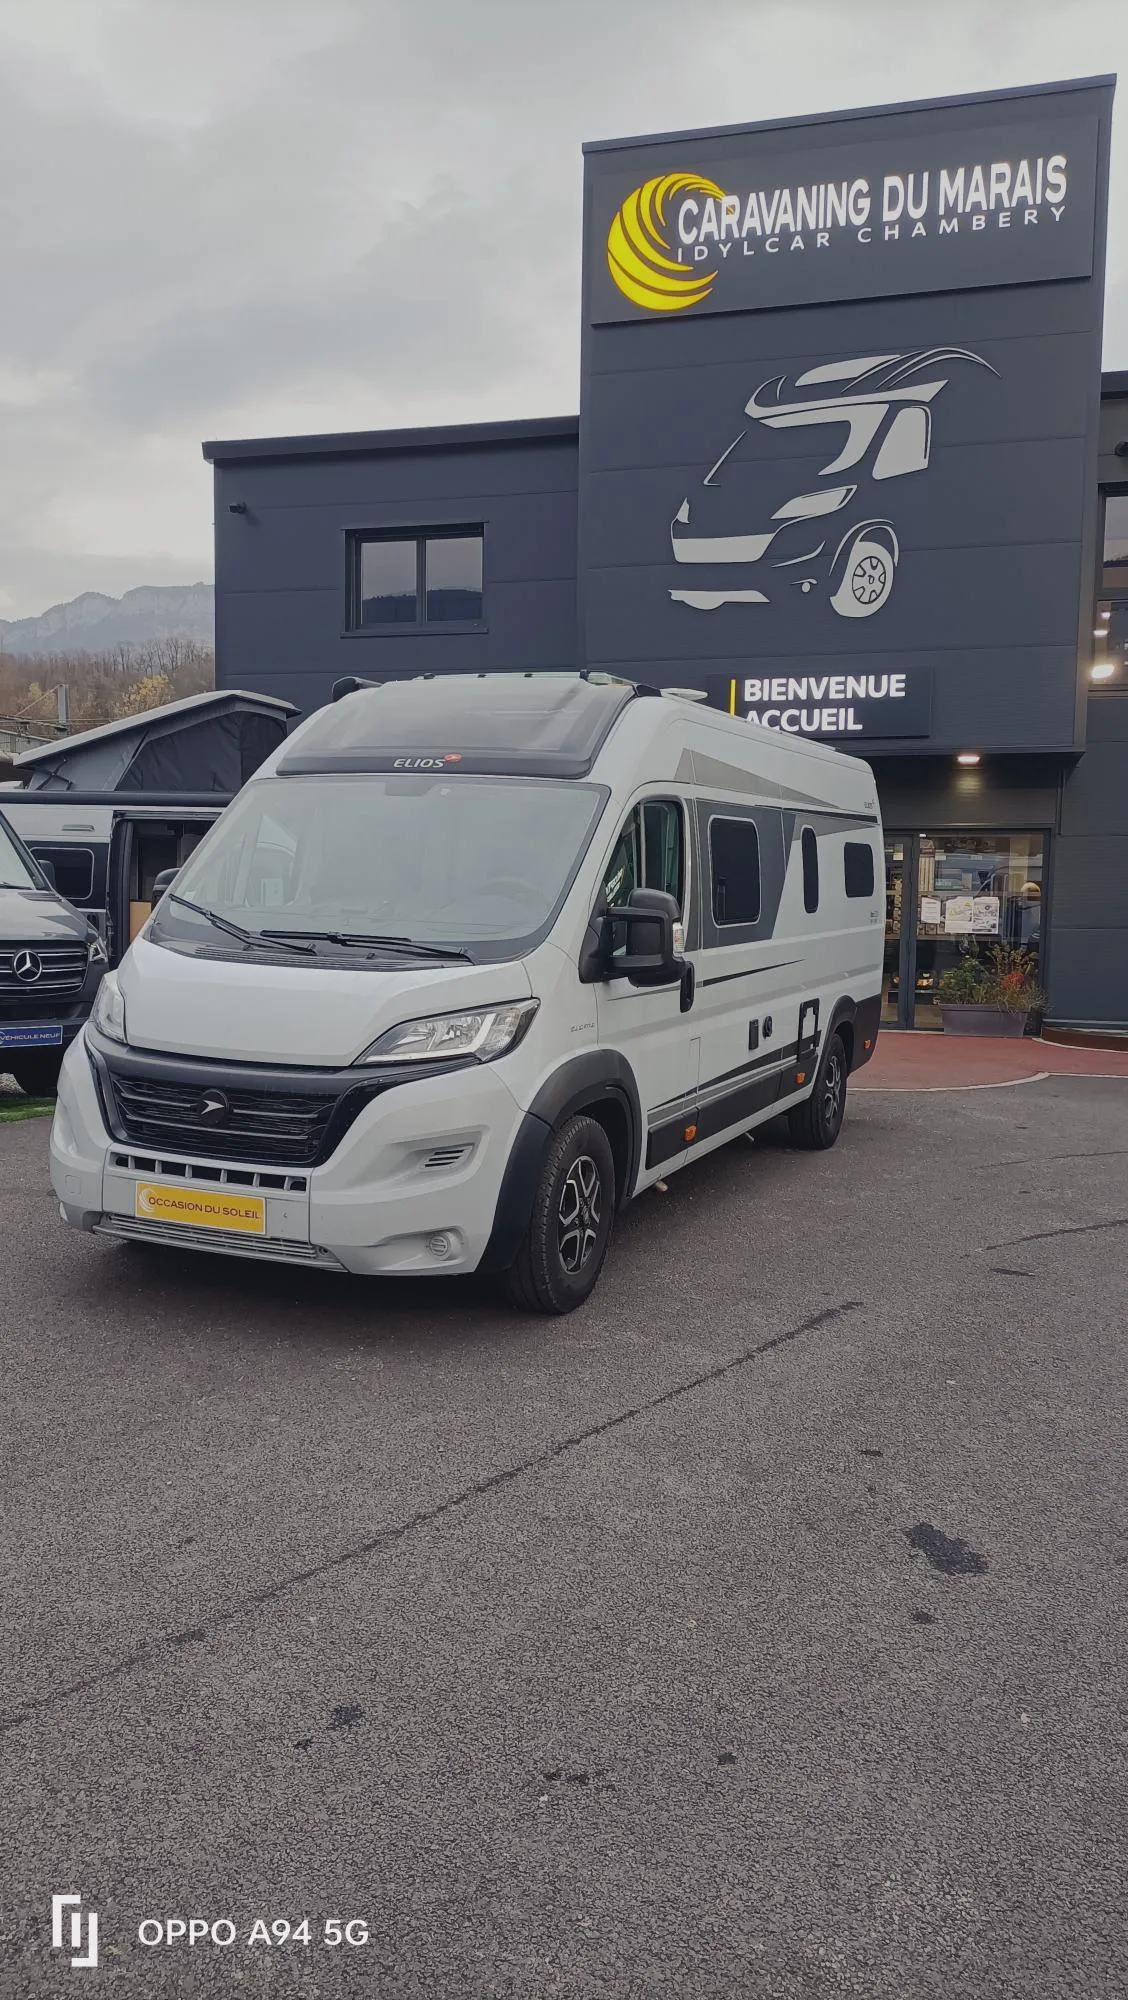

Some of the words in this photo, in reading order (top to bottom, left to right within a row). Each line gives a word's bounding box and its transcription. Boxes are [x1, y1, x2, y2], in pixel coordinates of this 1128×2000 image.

[678, 178, 871, 245] CARAVANING
[882, 173, 929, 223] DU
[938, 154, 1068, 215] MARAIS
[677, 231, 831, 263] IDYLCAR
[857, 205, 1066, 243] CHAMBERY
[744, 673, 907, 702] BIENVENUE
[393, 758, 445, 768] ELIOS
[148, 1196, 203, 1212] OCCASION
[204, 1205, 221, 1214] DU
[222, 1207, 261, 1219] SOLEIL
